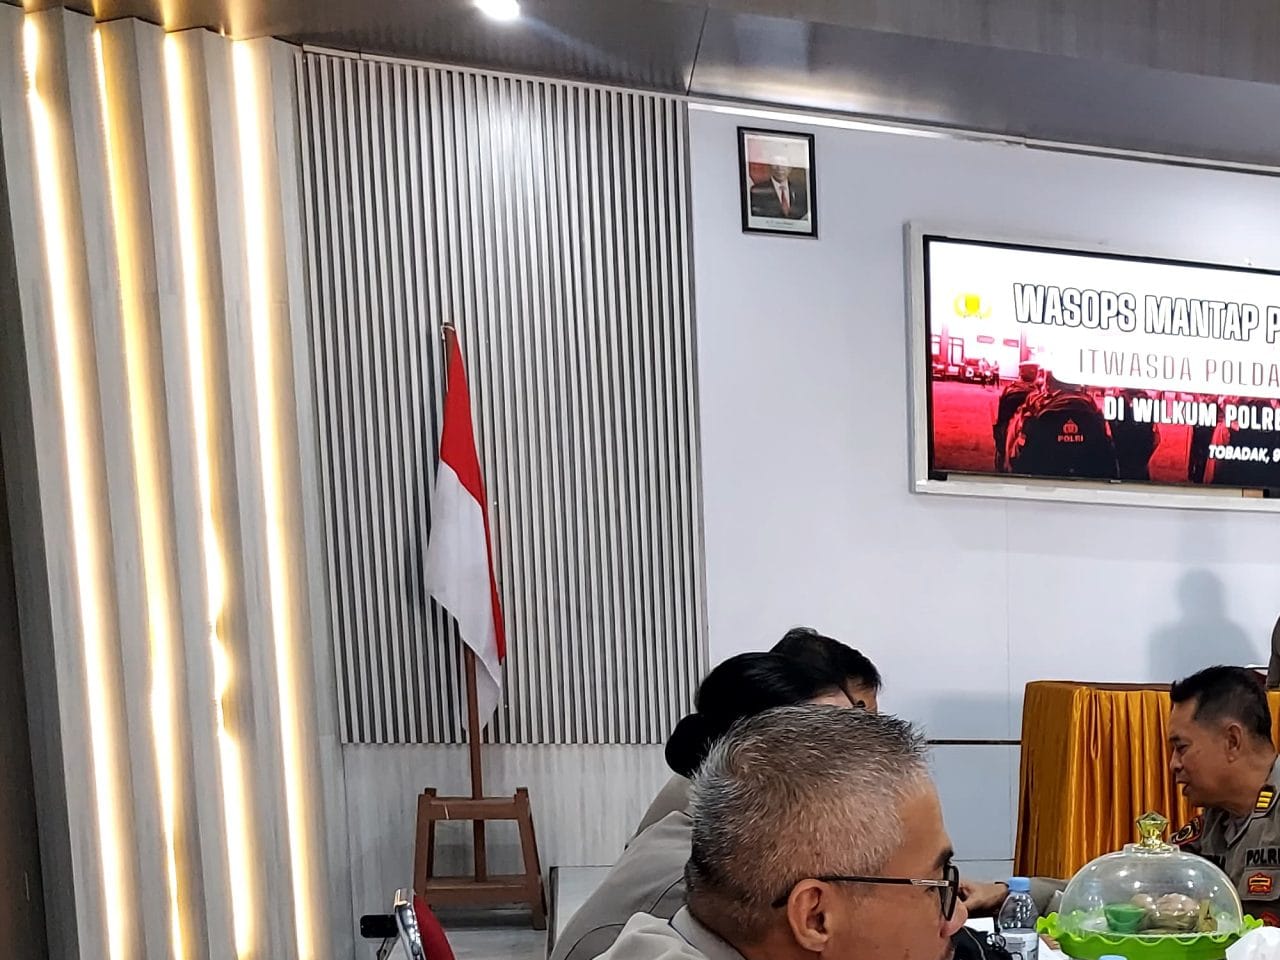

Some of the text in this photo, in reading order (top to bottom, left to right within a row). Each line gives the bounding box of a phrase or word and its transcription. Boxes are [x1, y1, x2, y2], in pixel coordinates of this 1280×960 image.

[1013, 282, 1136, 332] WASOPS
[1144, 294, 1259, 342] MANTAP
[1079, 348, 1192, 381] ITWASDA
[1205, 358, 1280, 388] POLDA
[1104, 396, 1124, 421] DI
[1133, 397, 1217, 428] WILKUM
[1209, 444, 1270, 463] TOBADAK,
[1272, 446, 1280, 463] 9
